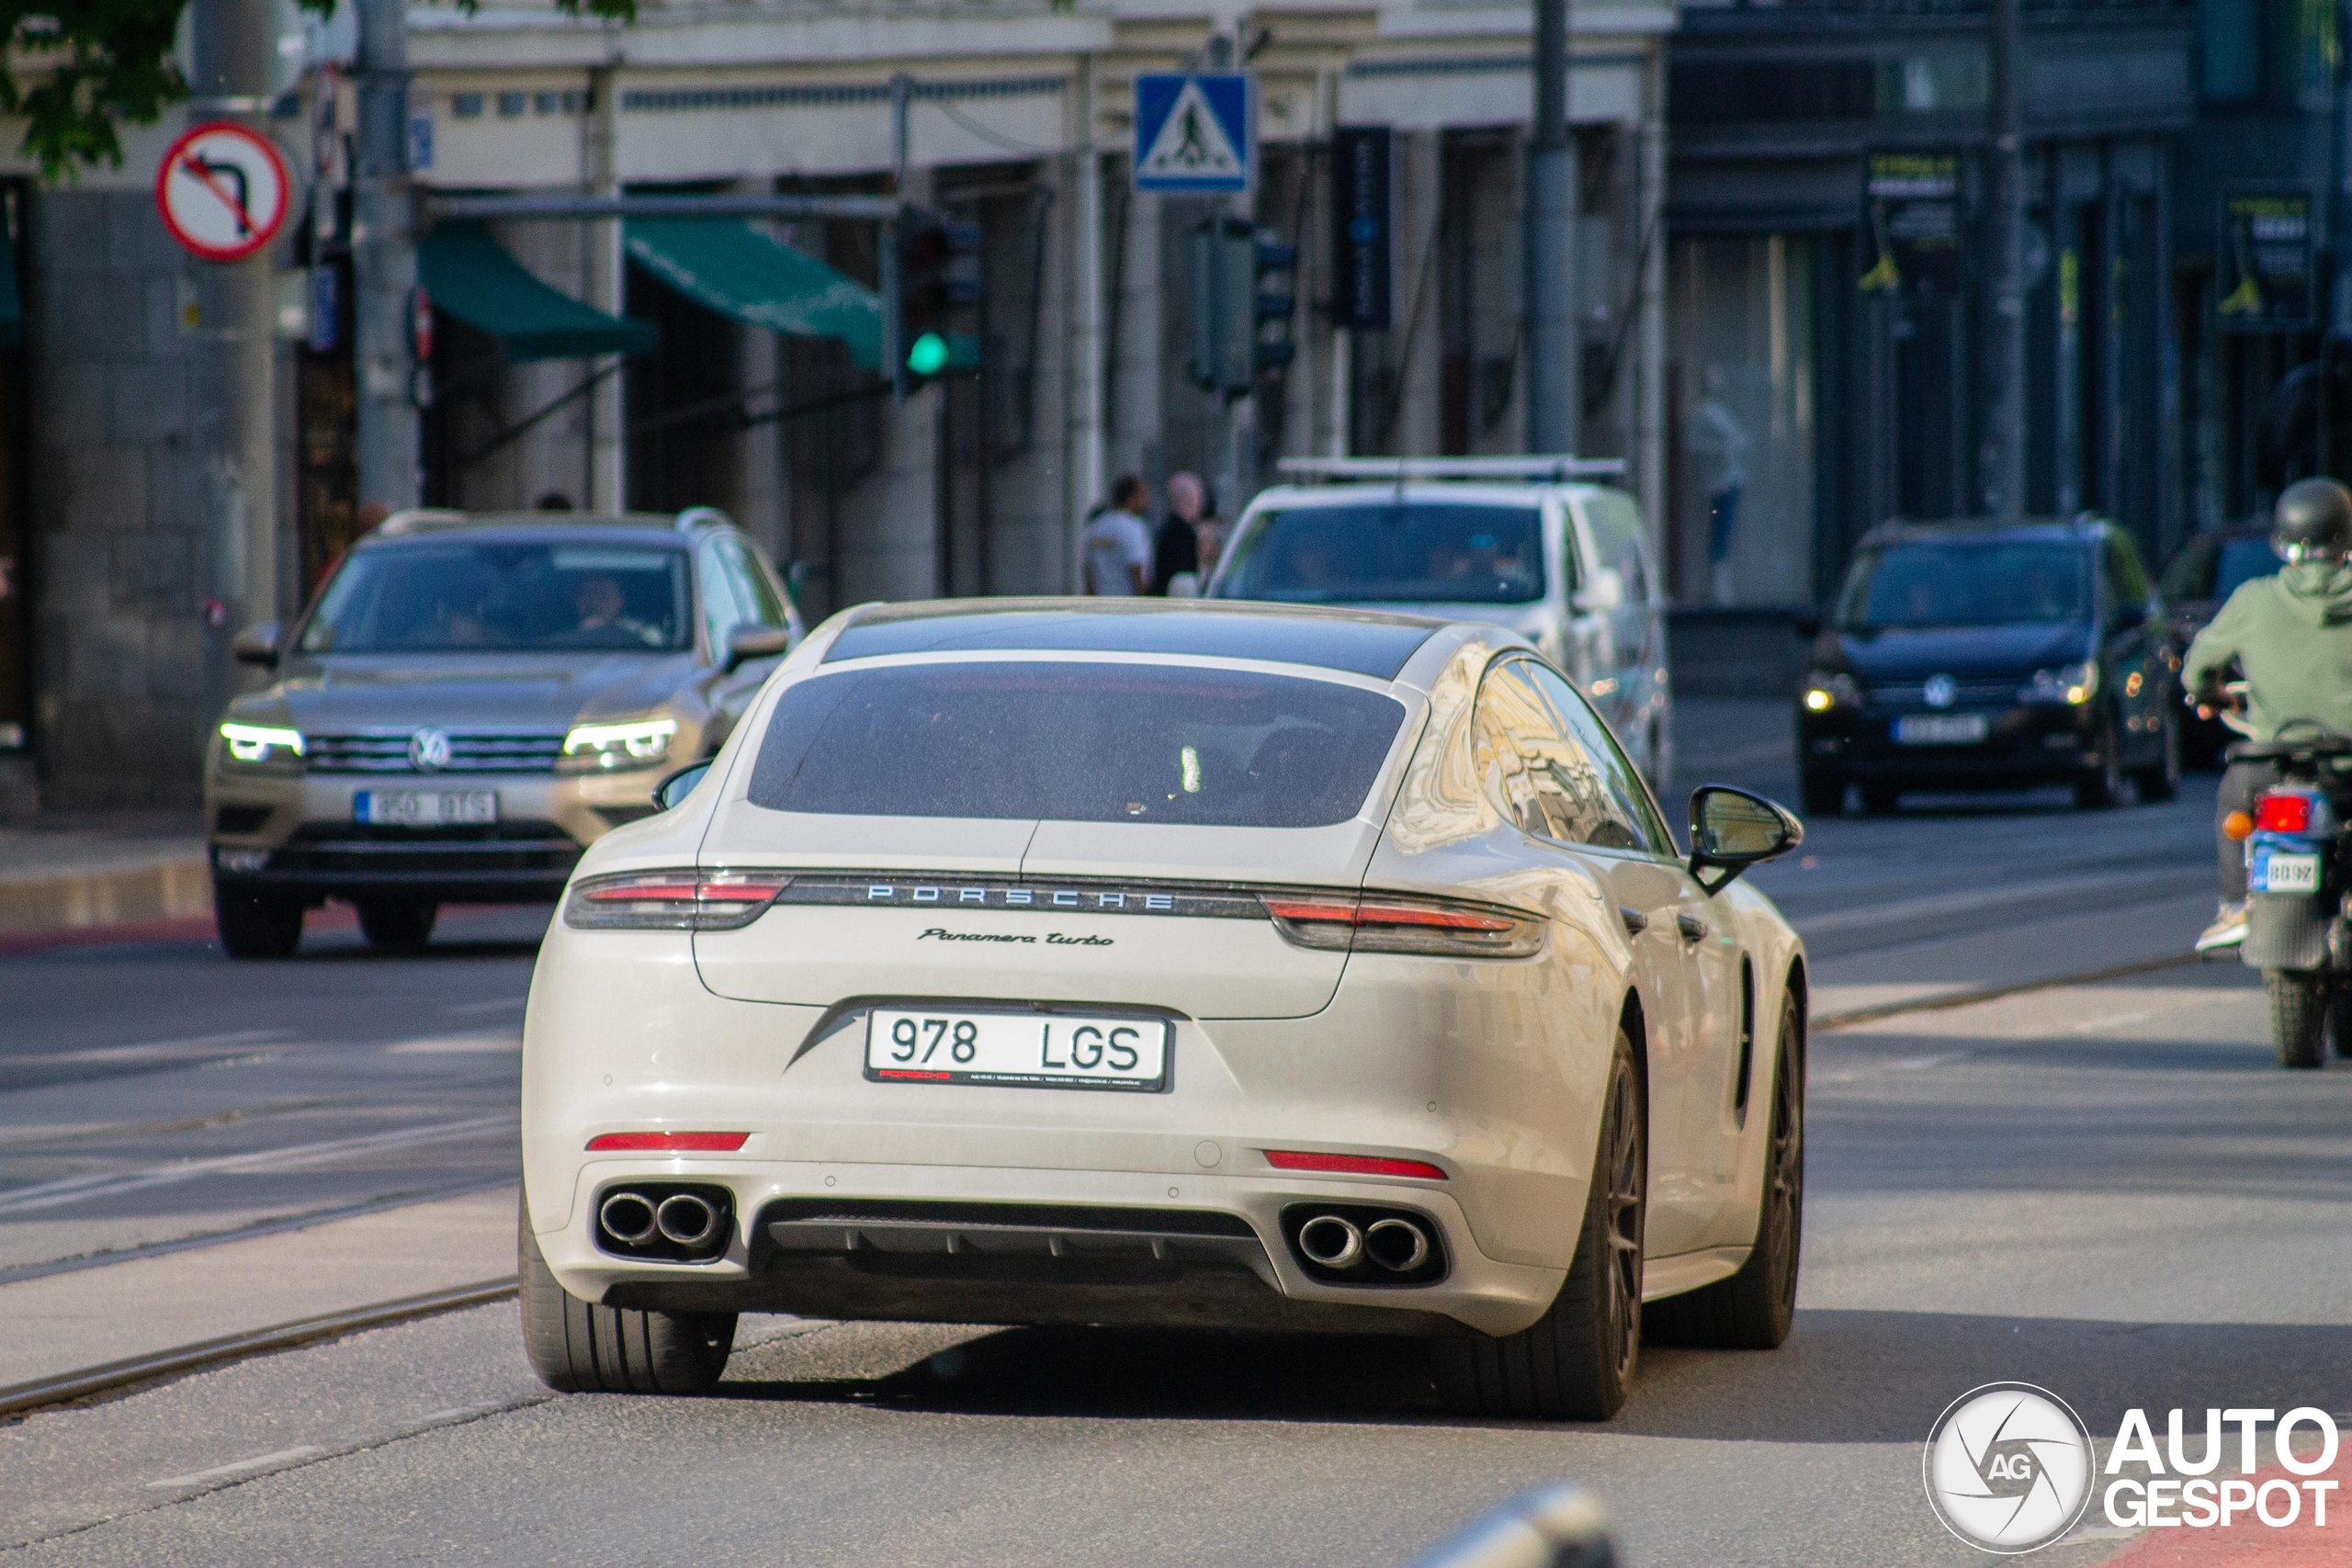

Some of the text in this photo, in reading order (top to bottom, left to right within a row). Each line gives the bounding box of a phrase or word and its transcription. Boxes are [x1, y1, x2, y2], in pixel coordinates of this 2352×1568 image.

[867, 885, 1173, 909] PORSCHE
[917, 928, 1036, 943] Panamera
[889, 1018, 1140, 1071] 978 LGS
